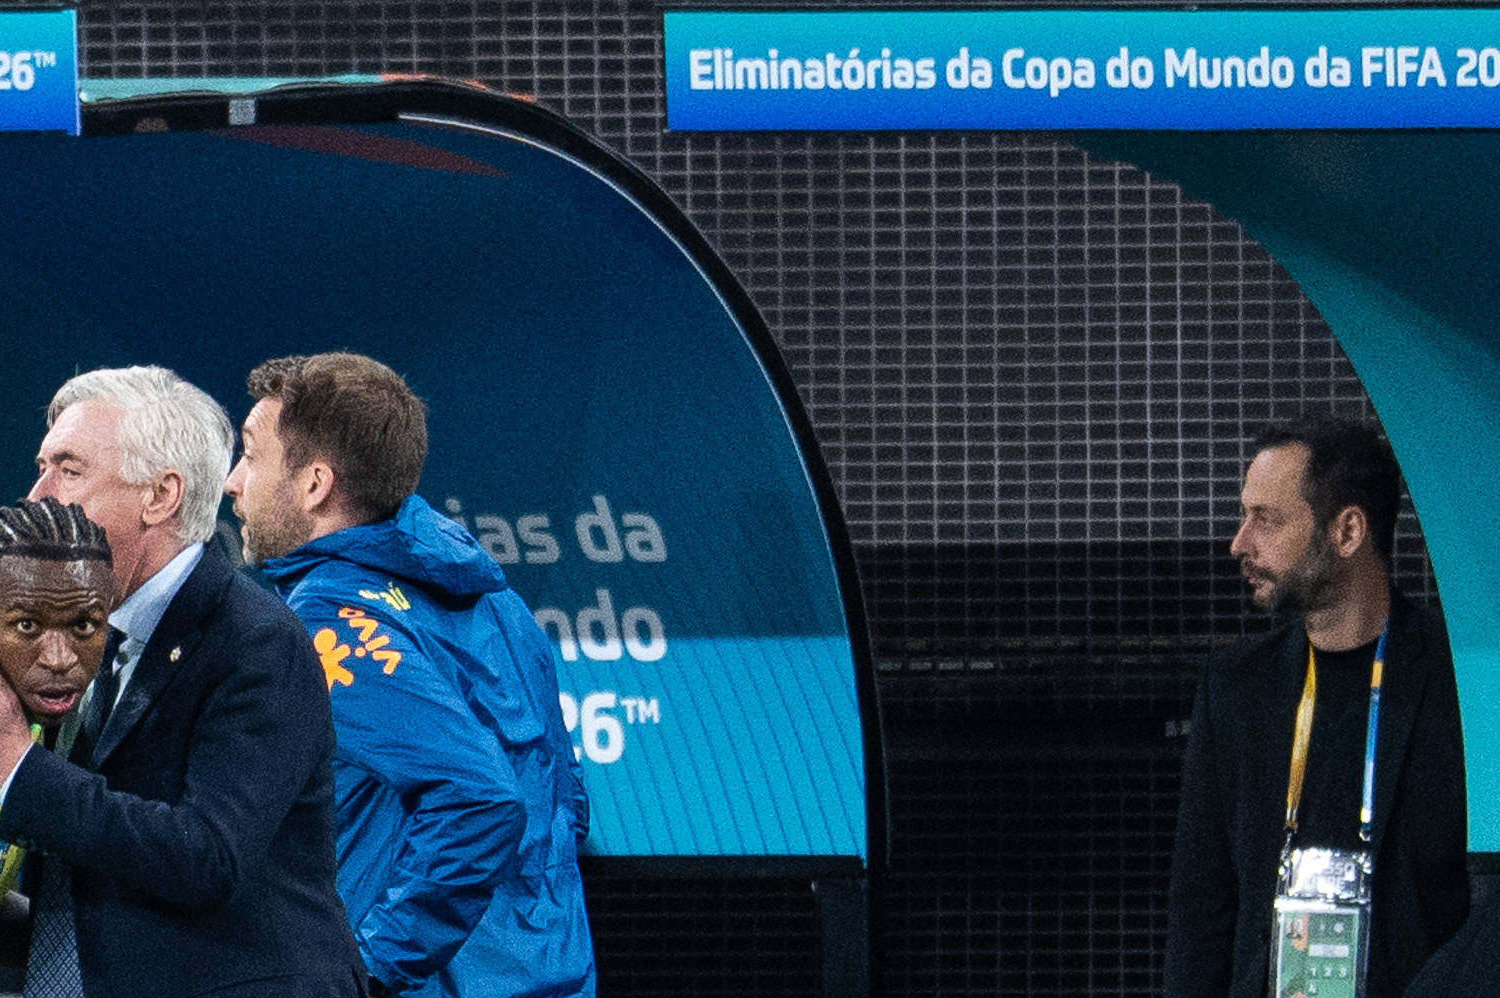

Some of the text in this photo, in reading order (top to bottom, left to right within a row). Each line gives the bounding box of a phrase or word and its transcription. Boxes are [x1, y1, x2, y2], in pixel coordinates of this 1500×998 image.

[690, 46, 1500, 97] Eliminatórias da Copa do Mundo da FIFA 20
[575, 495, 667, 562] da
[534, 589, 668, 661] ndo
